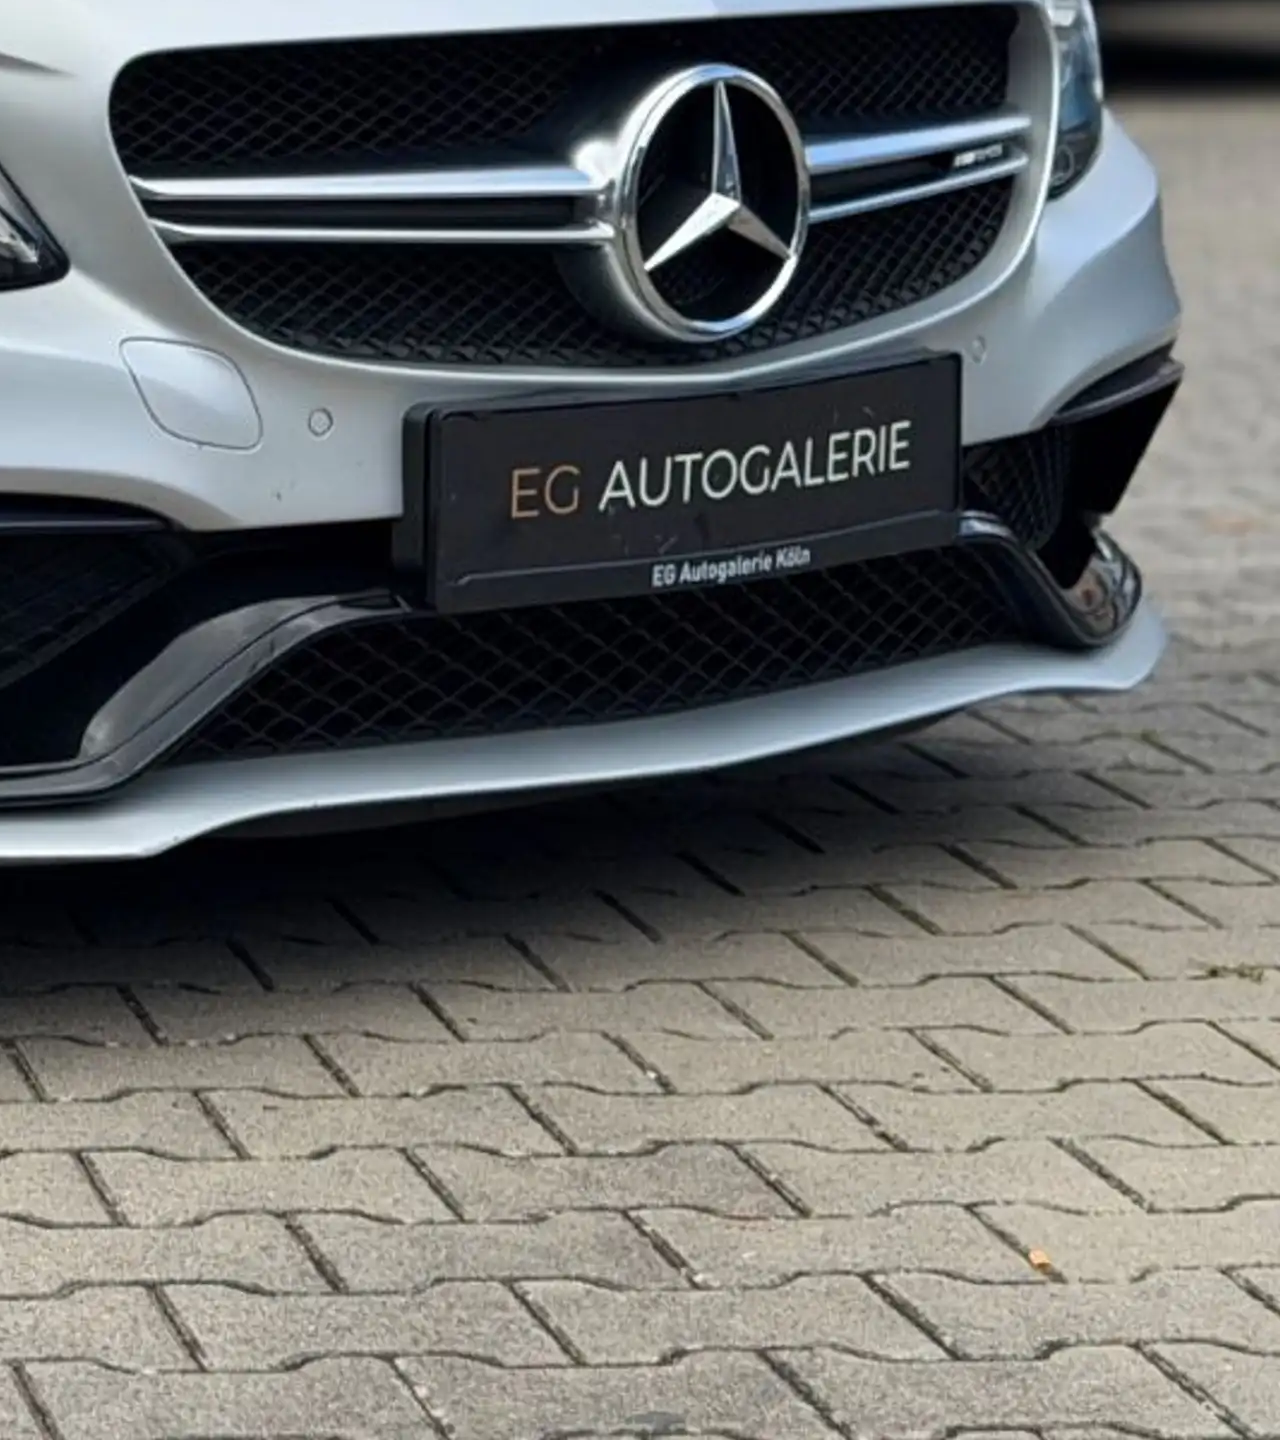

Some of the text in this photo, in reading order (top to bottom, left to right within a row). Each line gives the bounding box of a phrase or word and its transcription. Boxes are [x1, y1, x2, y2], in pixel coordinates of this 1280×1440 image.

[510, 419, 913, 520] EG AUTOGALERIE
[651, 544, 812, 588] EG Autogalerie Köln
